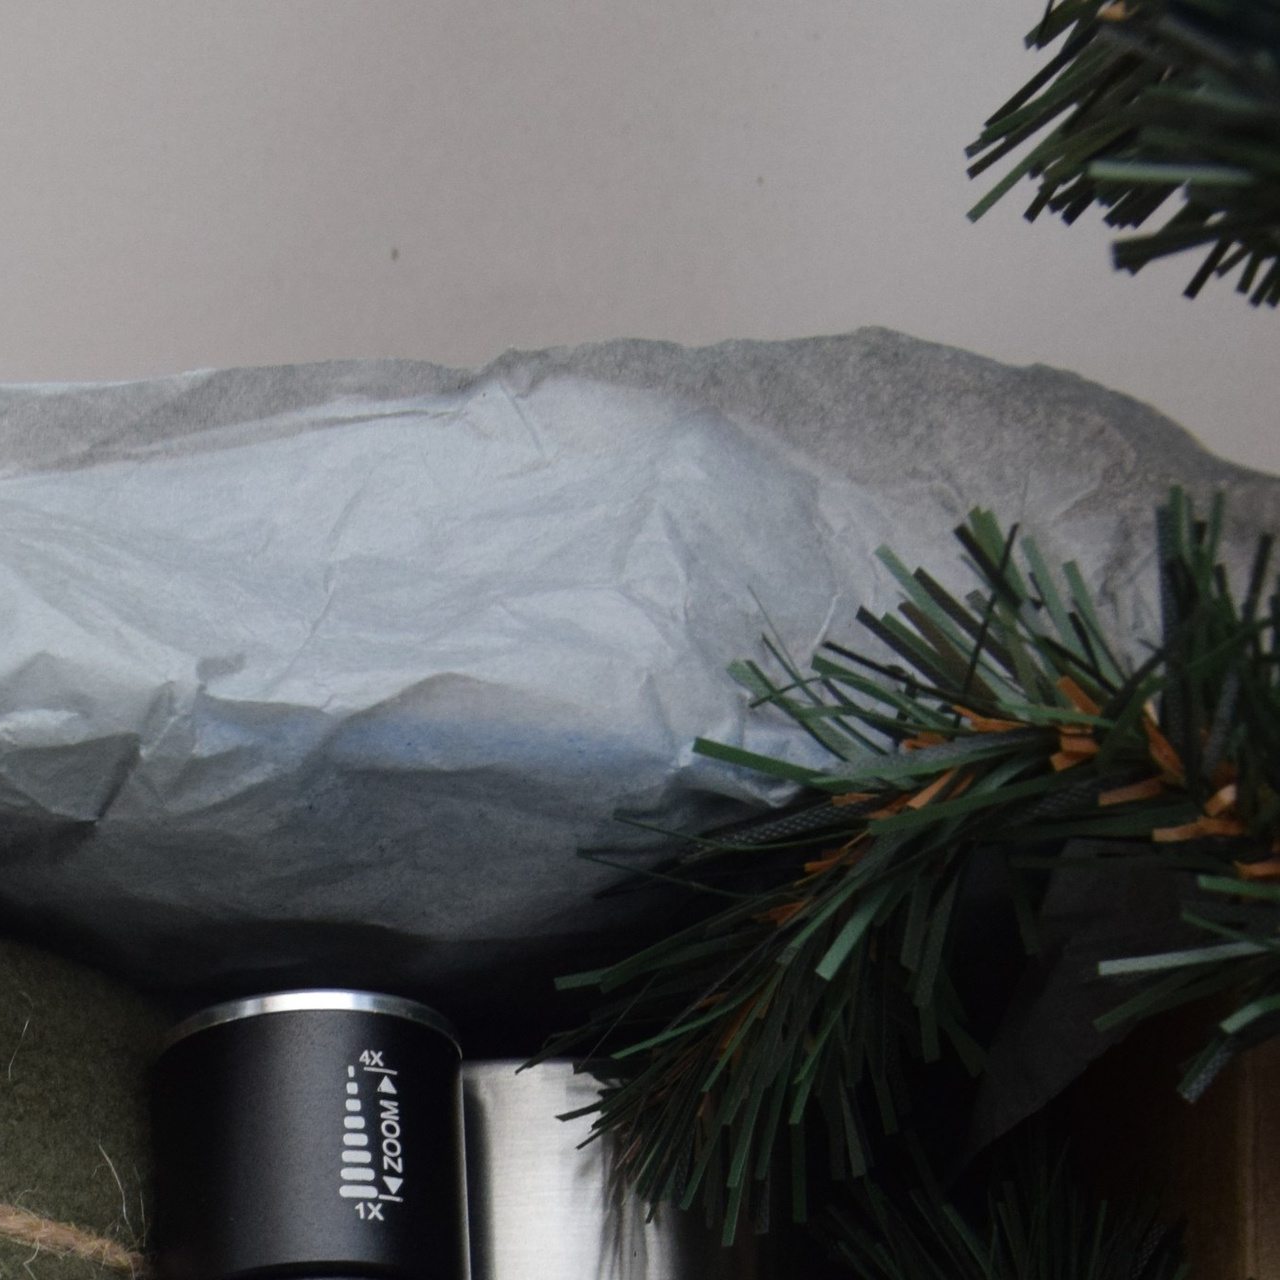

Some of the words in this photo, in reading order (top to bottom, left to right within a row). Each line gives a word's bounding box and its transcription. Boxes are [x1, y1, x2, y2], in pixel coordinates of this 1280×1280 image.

[358, 1049, 384, 1067] 4X
[380, 1099, 403, 1173] ZOOM
[354, 1203, 384, 1221] 1X
